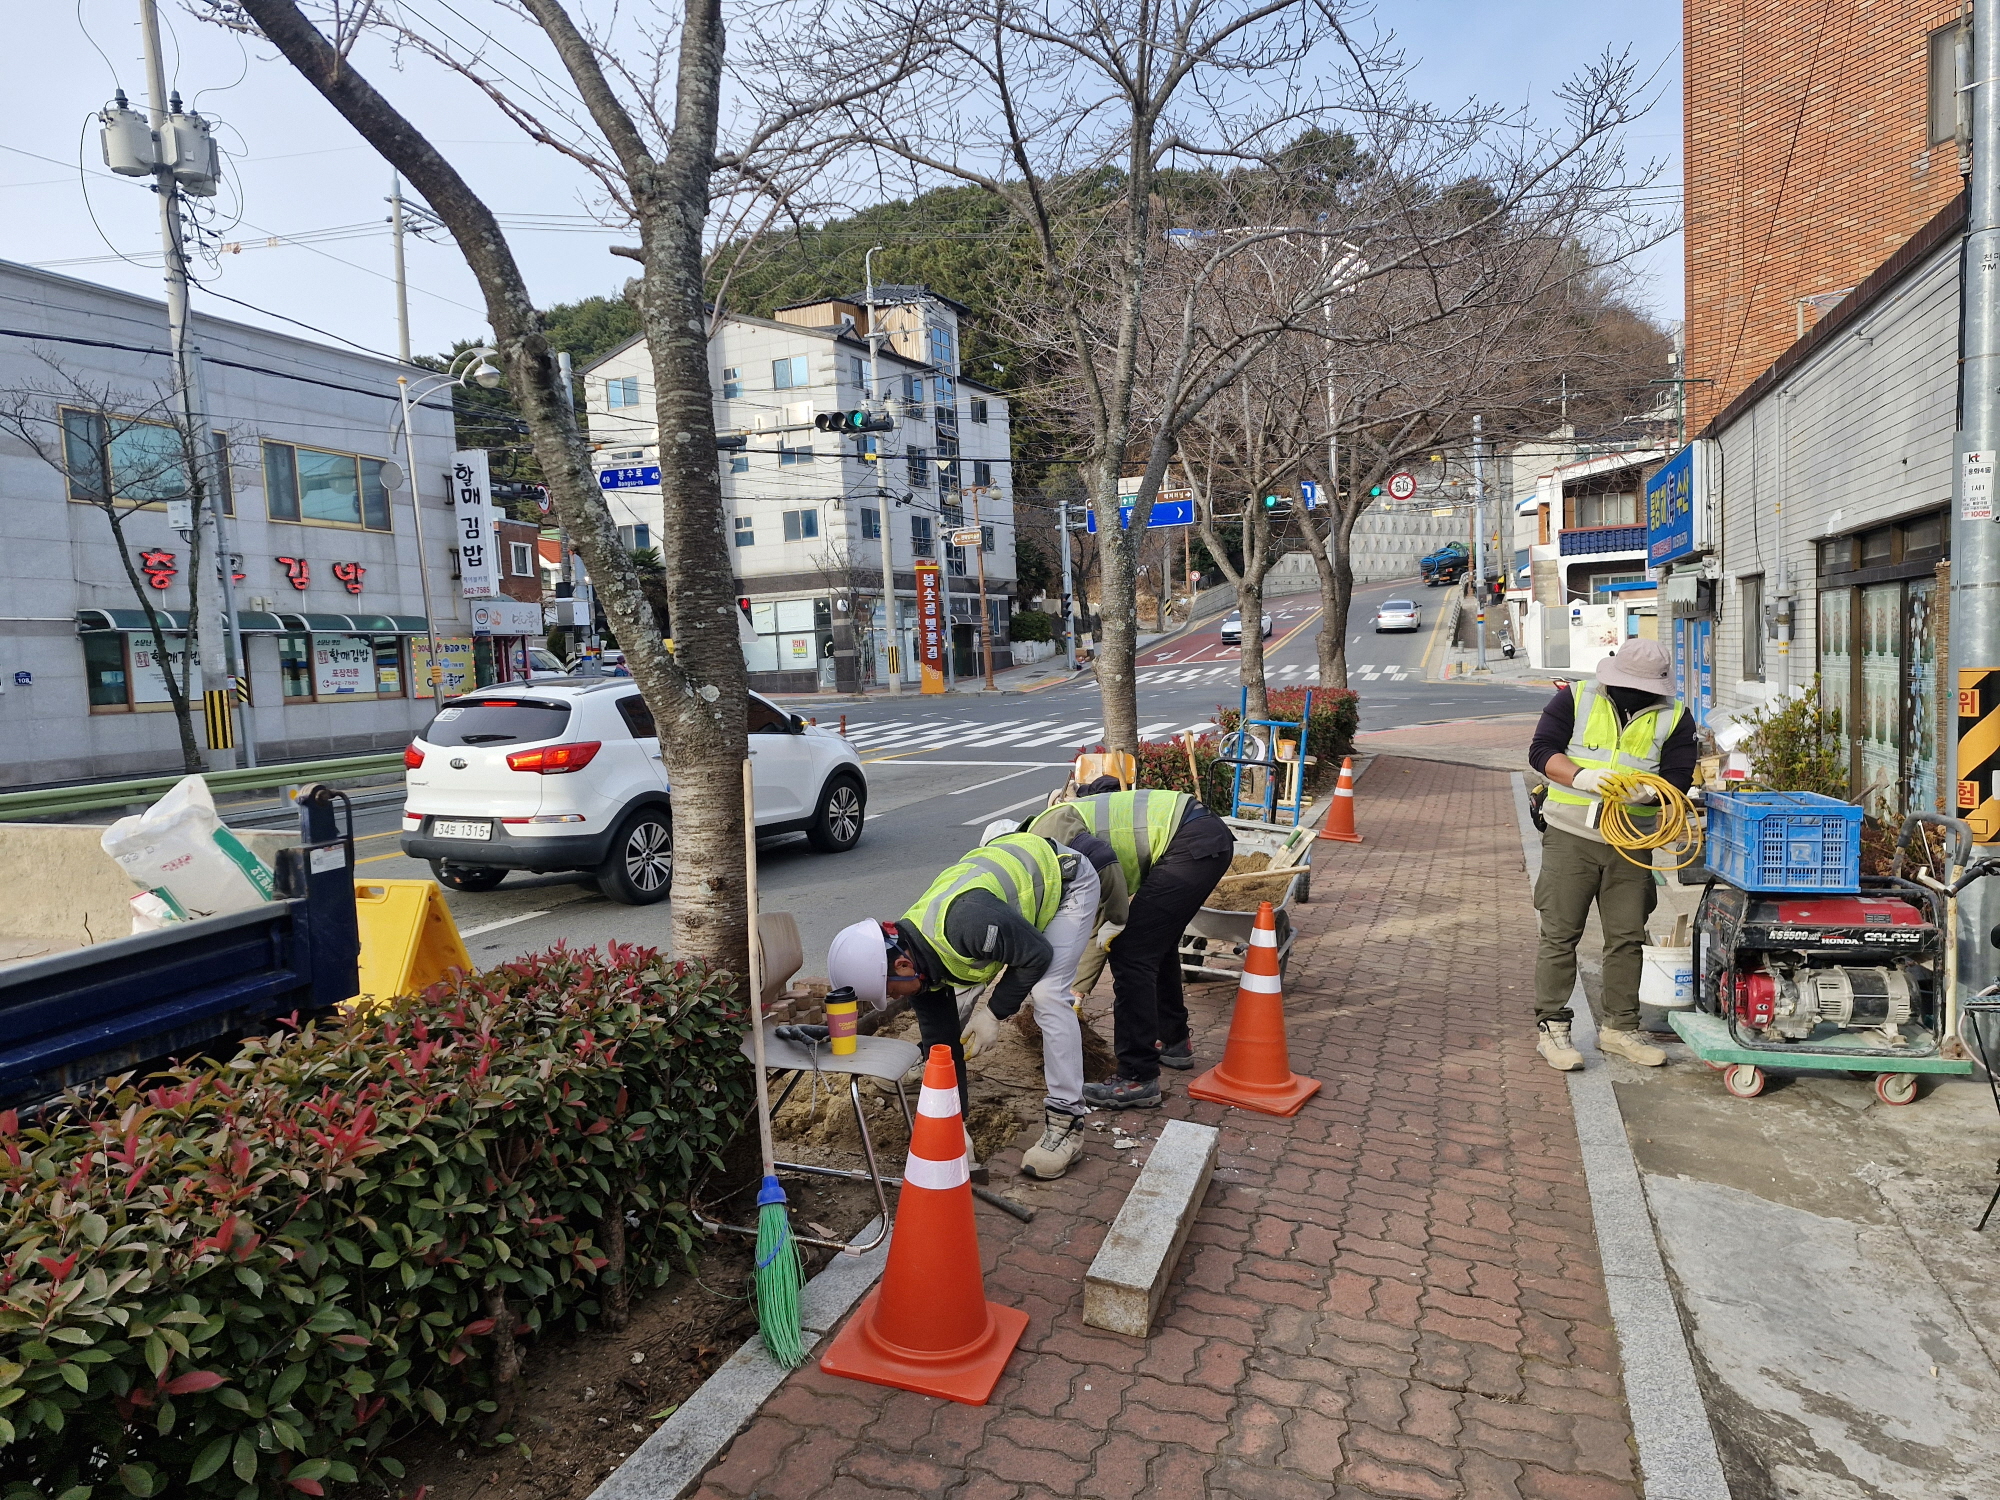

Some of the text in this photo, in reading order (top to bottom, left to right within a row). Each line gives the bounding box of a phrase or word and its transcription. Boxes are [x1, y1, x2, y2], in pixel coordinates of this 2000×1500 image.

[1968, 453, 1980, 463] kt
[602, 468, 659, 483] 49 봉수로 45
[1395, 481, 1409, 493] 50
[463, 586, 490, 595] 642-7585
[332, 668, 359, 677] 포장전문
[451, 758, 466, 768] KIA
[461, 824, 485, 837] 1315
